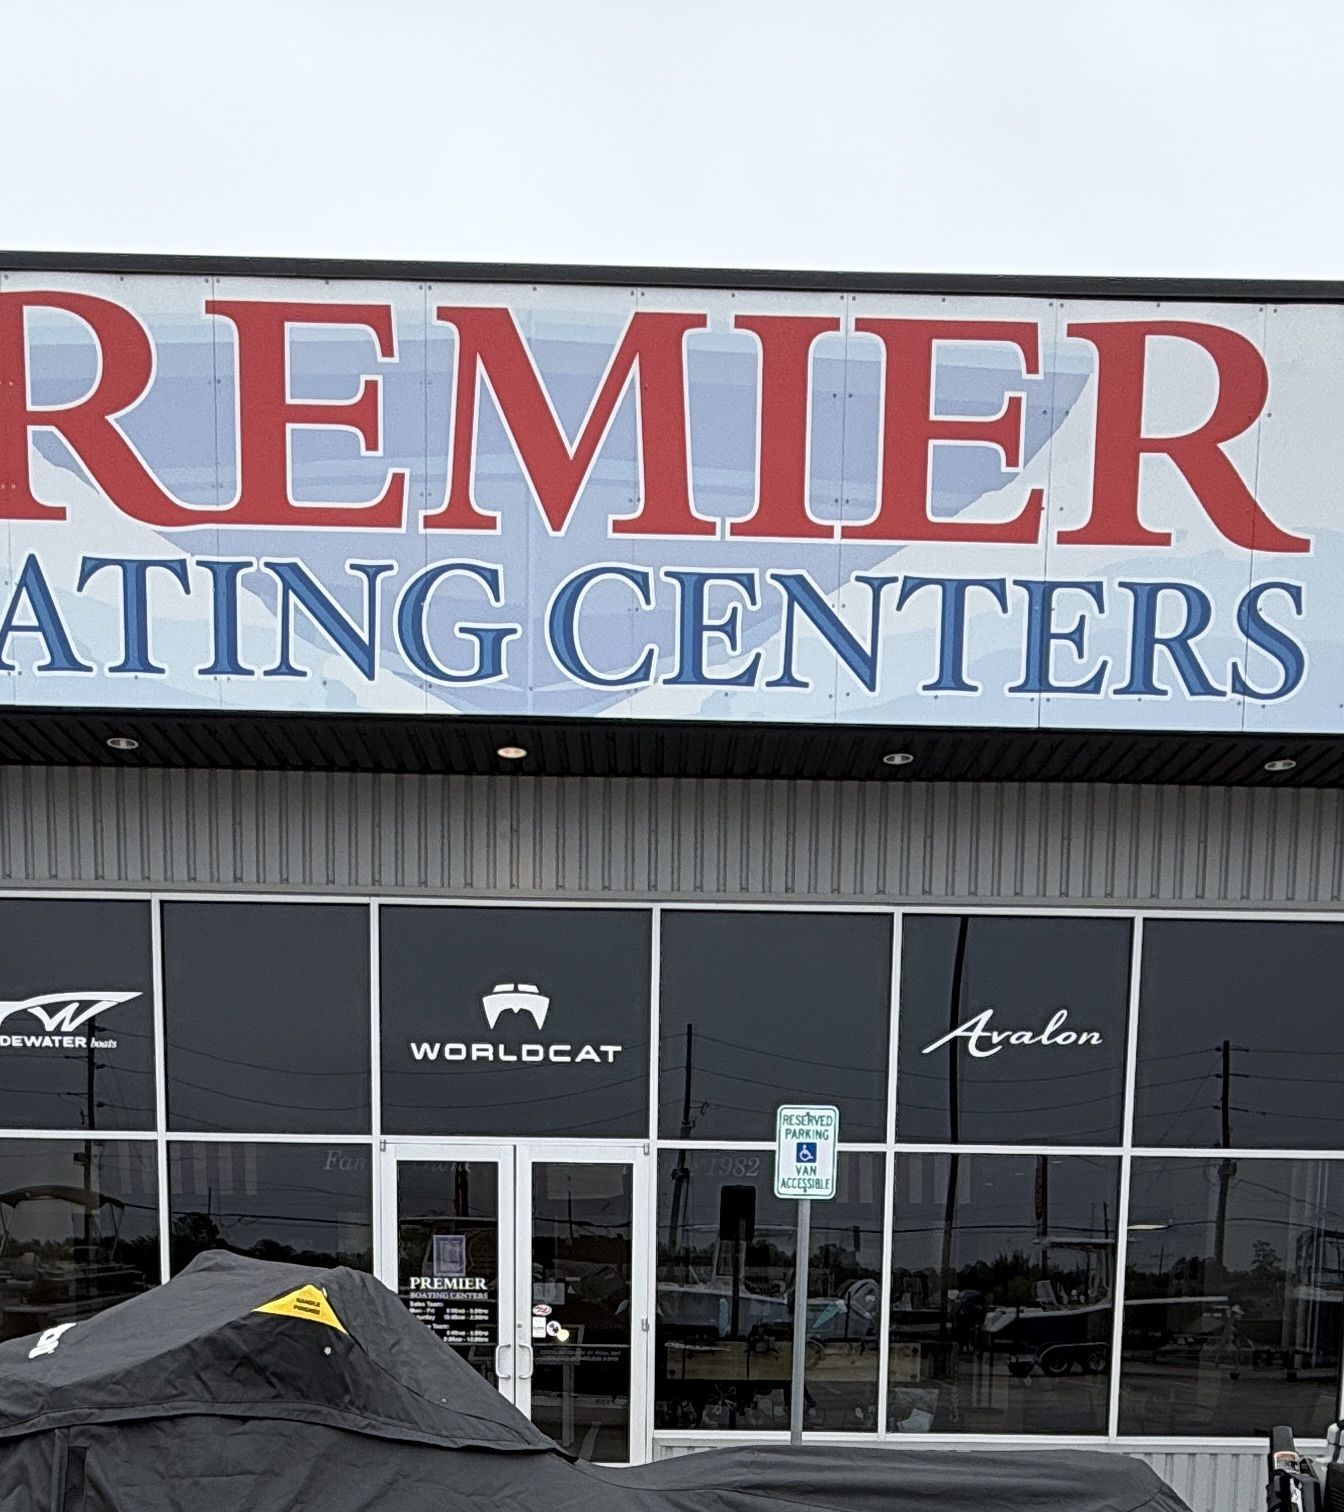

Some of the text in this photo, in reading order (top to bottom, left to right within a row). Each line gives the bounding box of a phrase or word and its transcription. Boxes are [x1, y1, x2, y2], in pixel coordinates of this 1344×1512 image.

[547, 562, 1307, 701] CENTERS
[922, 1009, 1102, 1057] Avalon
[90, 1038, 117, 1049] boats
[410, 1042, 622, 1063] WORLDCAT
[782, 1113, 833, 1127] RESERVED
[785, 1128, 829, 1141] PARKING
[796, 1165, 816, 1176] VAN
[780, 1178, 831, 1189] ACCESSIBLE
[409, 1276, 488, 1290] PREMIER
[409, 1291, 489, 1300] BOATING CENTERS
